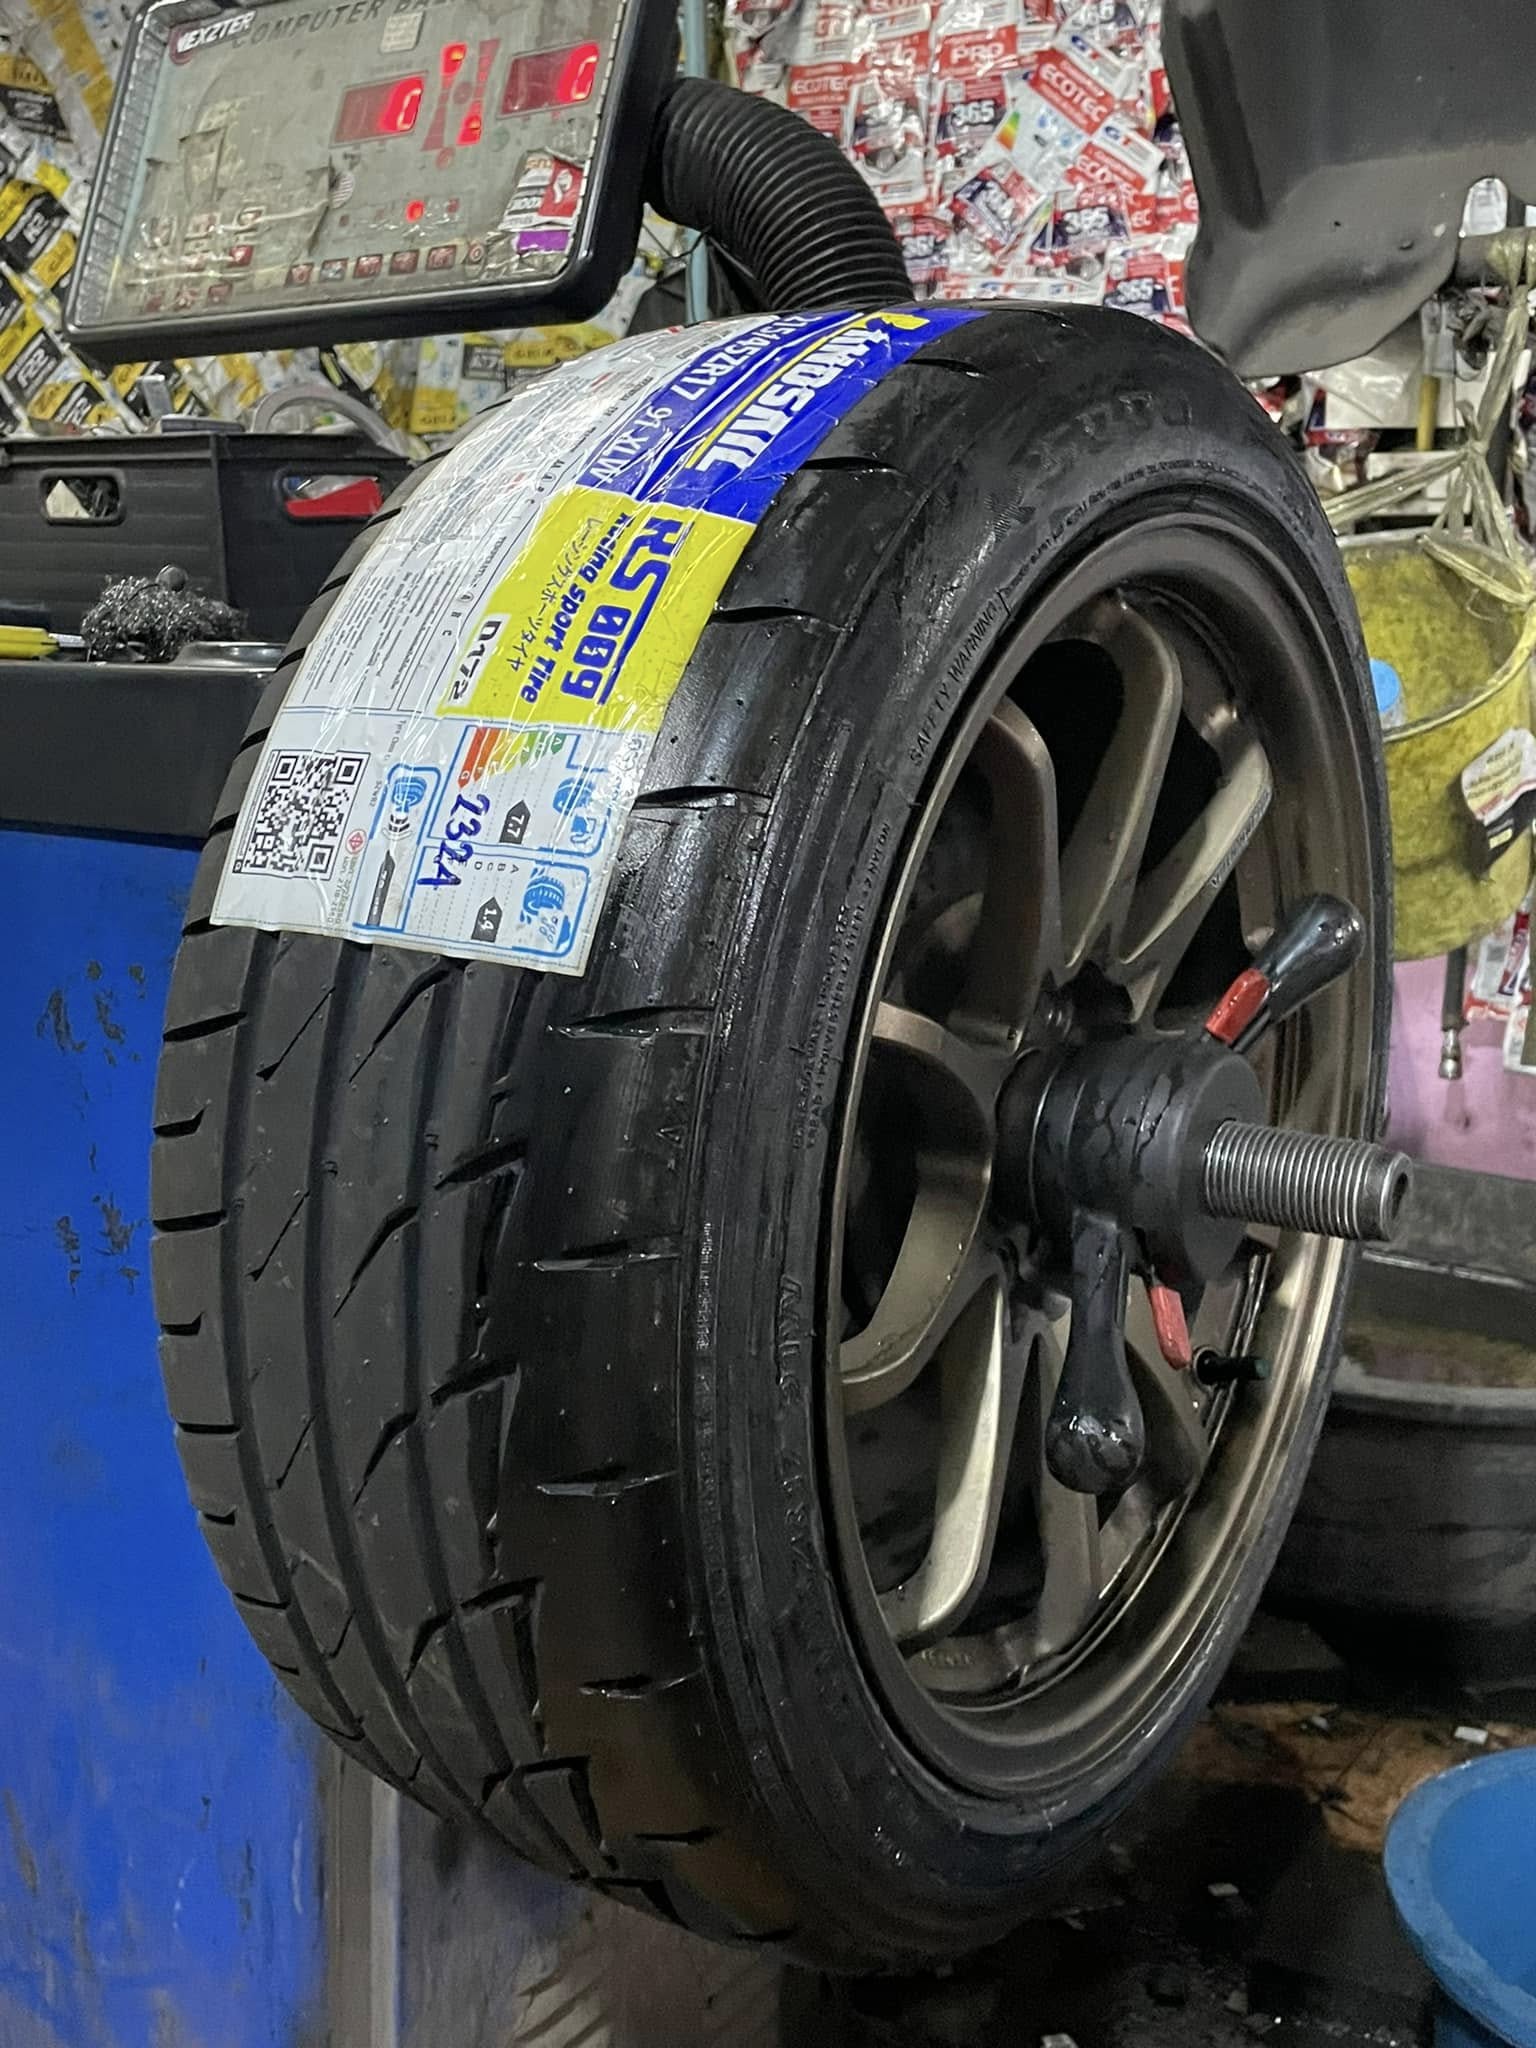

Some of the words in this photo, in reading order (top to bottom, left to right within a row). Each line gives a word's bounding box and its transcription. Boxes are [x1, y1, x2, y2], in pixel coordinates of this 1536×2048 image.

[1039, 62, 1108, 123] ECOTEC
[954, 101, 995, 125] 365
[520, 656, 556, 704] Tire
[506, 810, 527, 838] 7.7
[480, 905, 500, 933] 1.4
